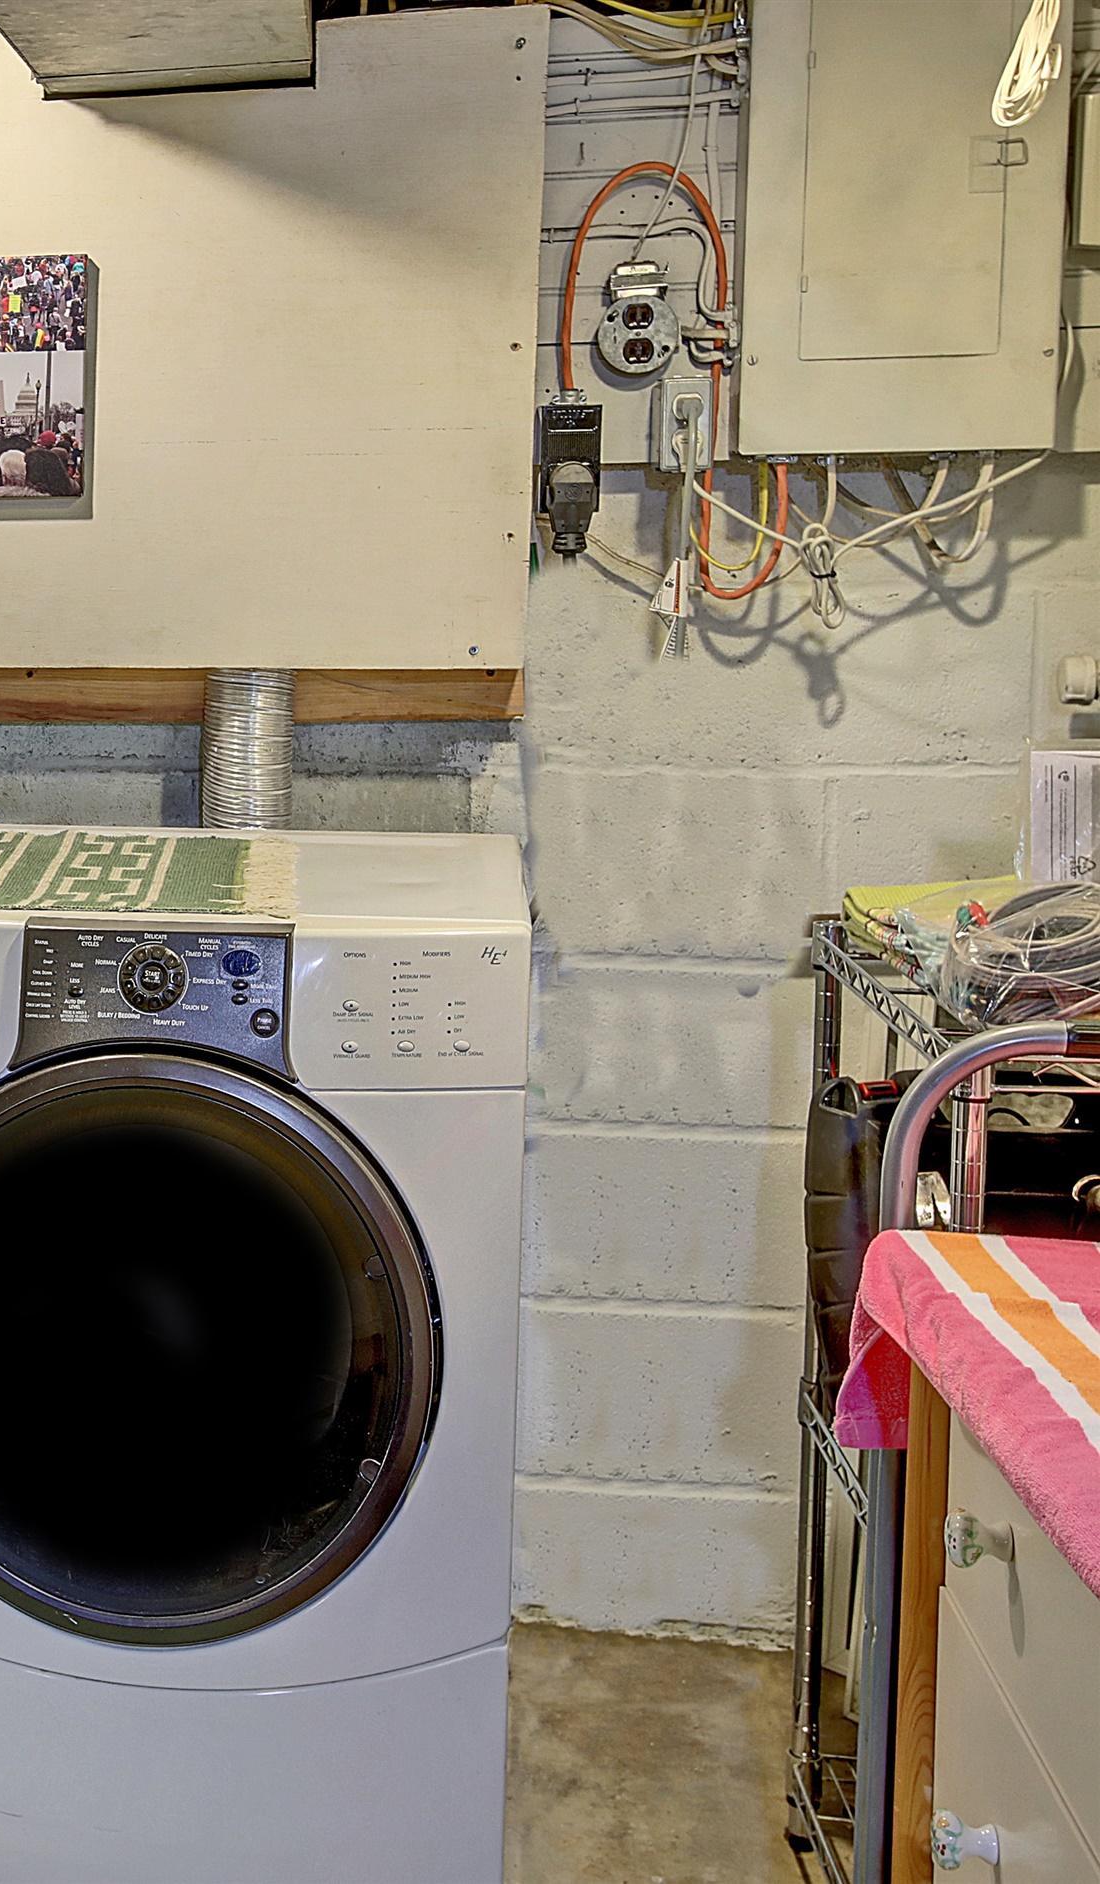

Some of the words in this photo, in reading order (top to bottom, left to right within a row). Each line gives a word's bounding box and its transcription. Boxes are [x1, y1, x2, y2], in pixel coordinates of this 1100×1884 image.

[143, 932, 168, 940] DELICATE
[198, 937, 222, 945] MANUAL
[94, 958, 118, 966] NORMAL
[99, 986, 116, 994] JEANS
[182, 1003, 200, 1011] TOUCH
[152, 1018, 171, 1026] HEAVY
